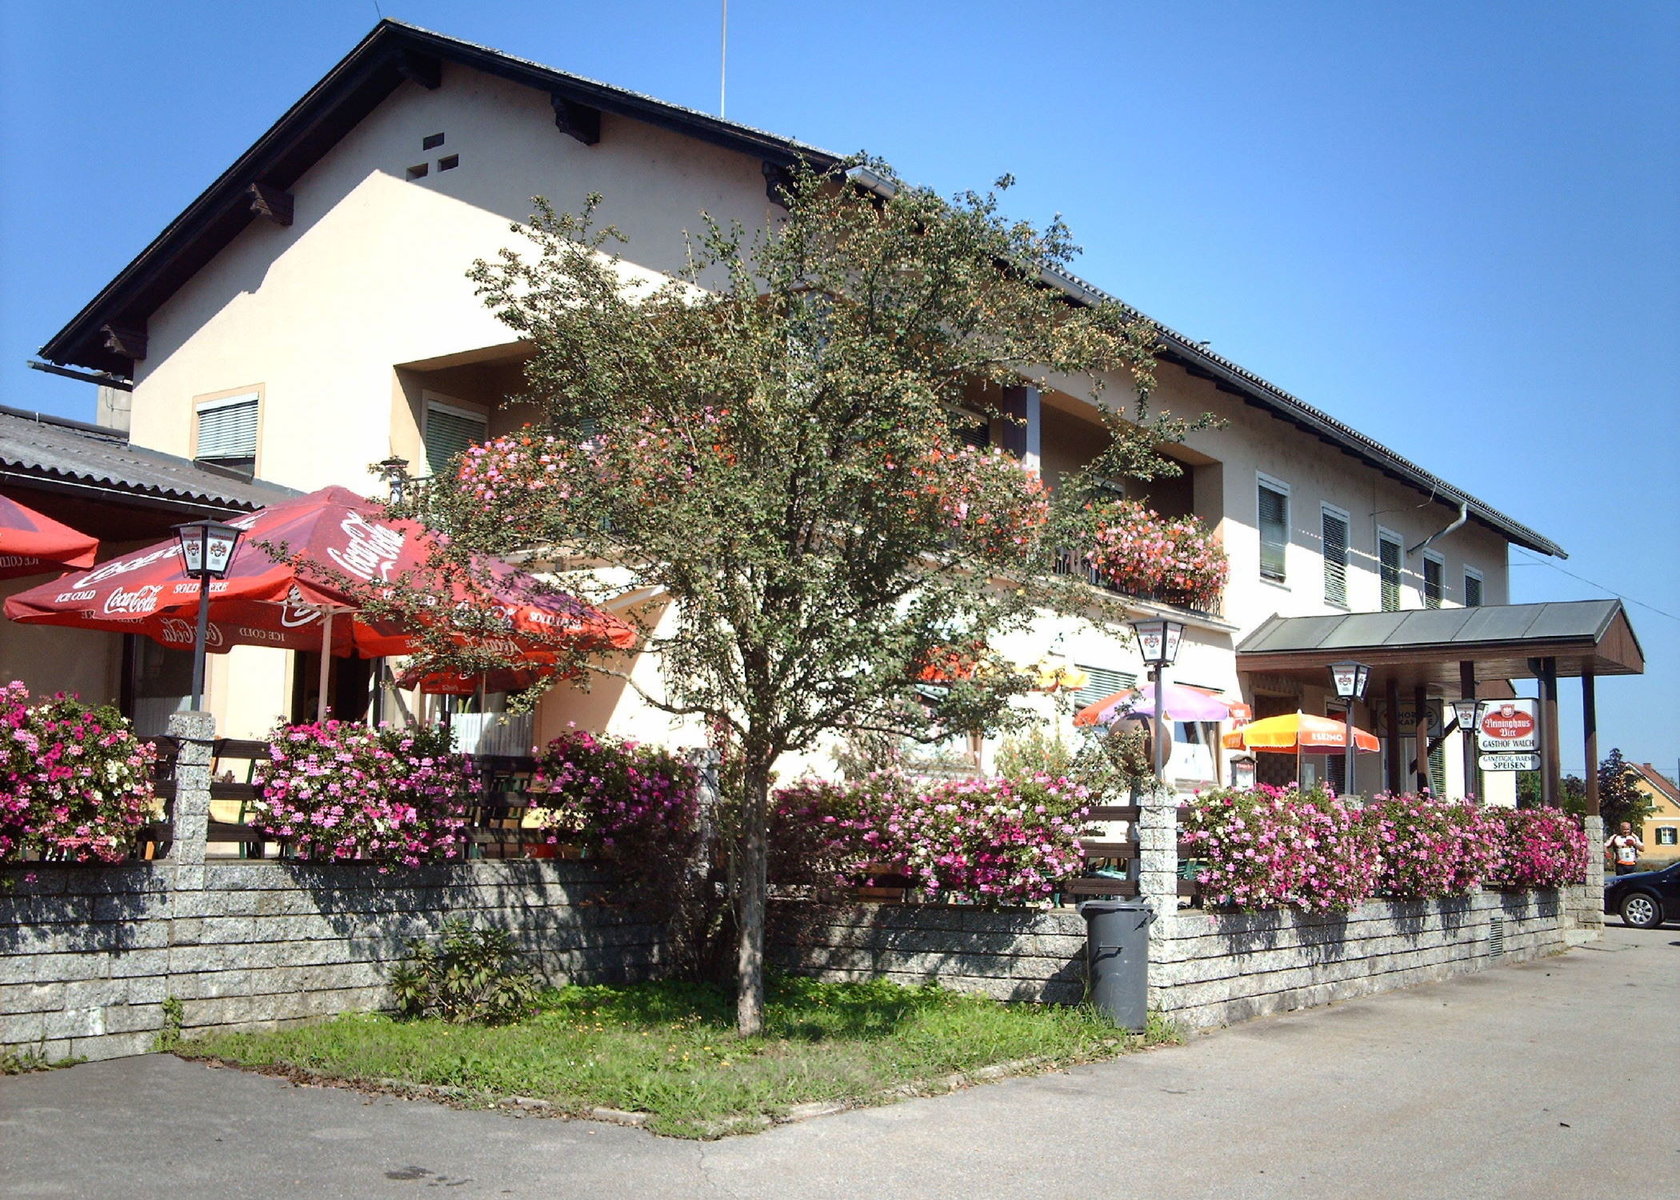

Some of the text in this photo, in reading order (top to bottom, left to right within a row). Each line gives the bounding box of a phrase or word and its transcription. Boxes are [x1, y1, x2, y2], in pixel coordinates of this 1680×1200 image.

[1482, 739, 1535, 748] GASTHOF WALCH
[1493, 761, 1526, 769] SPEISEN
